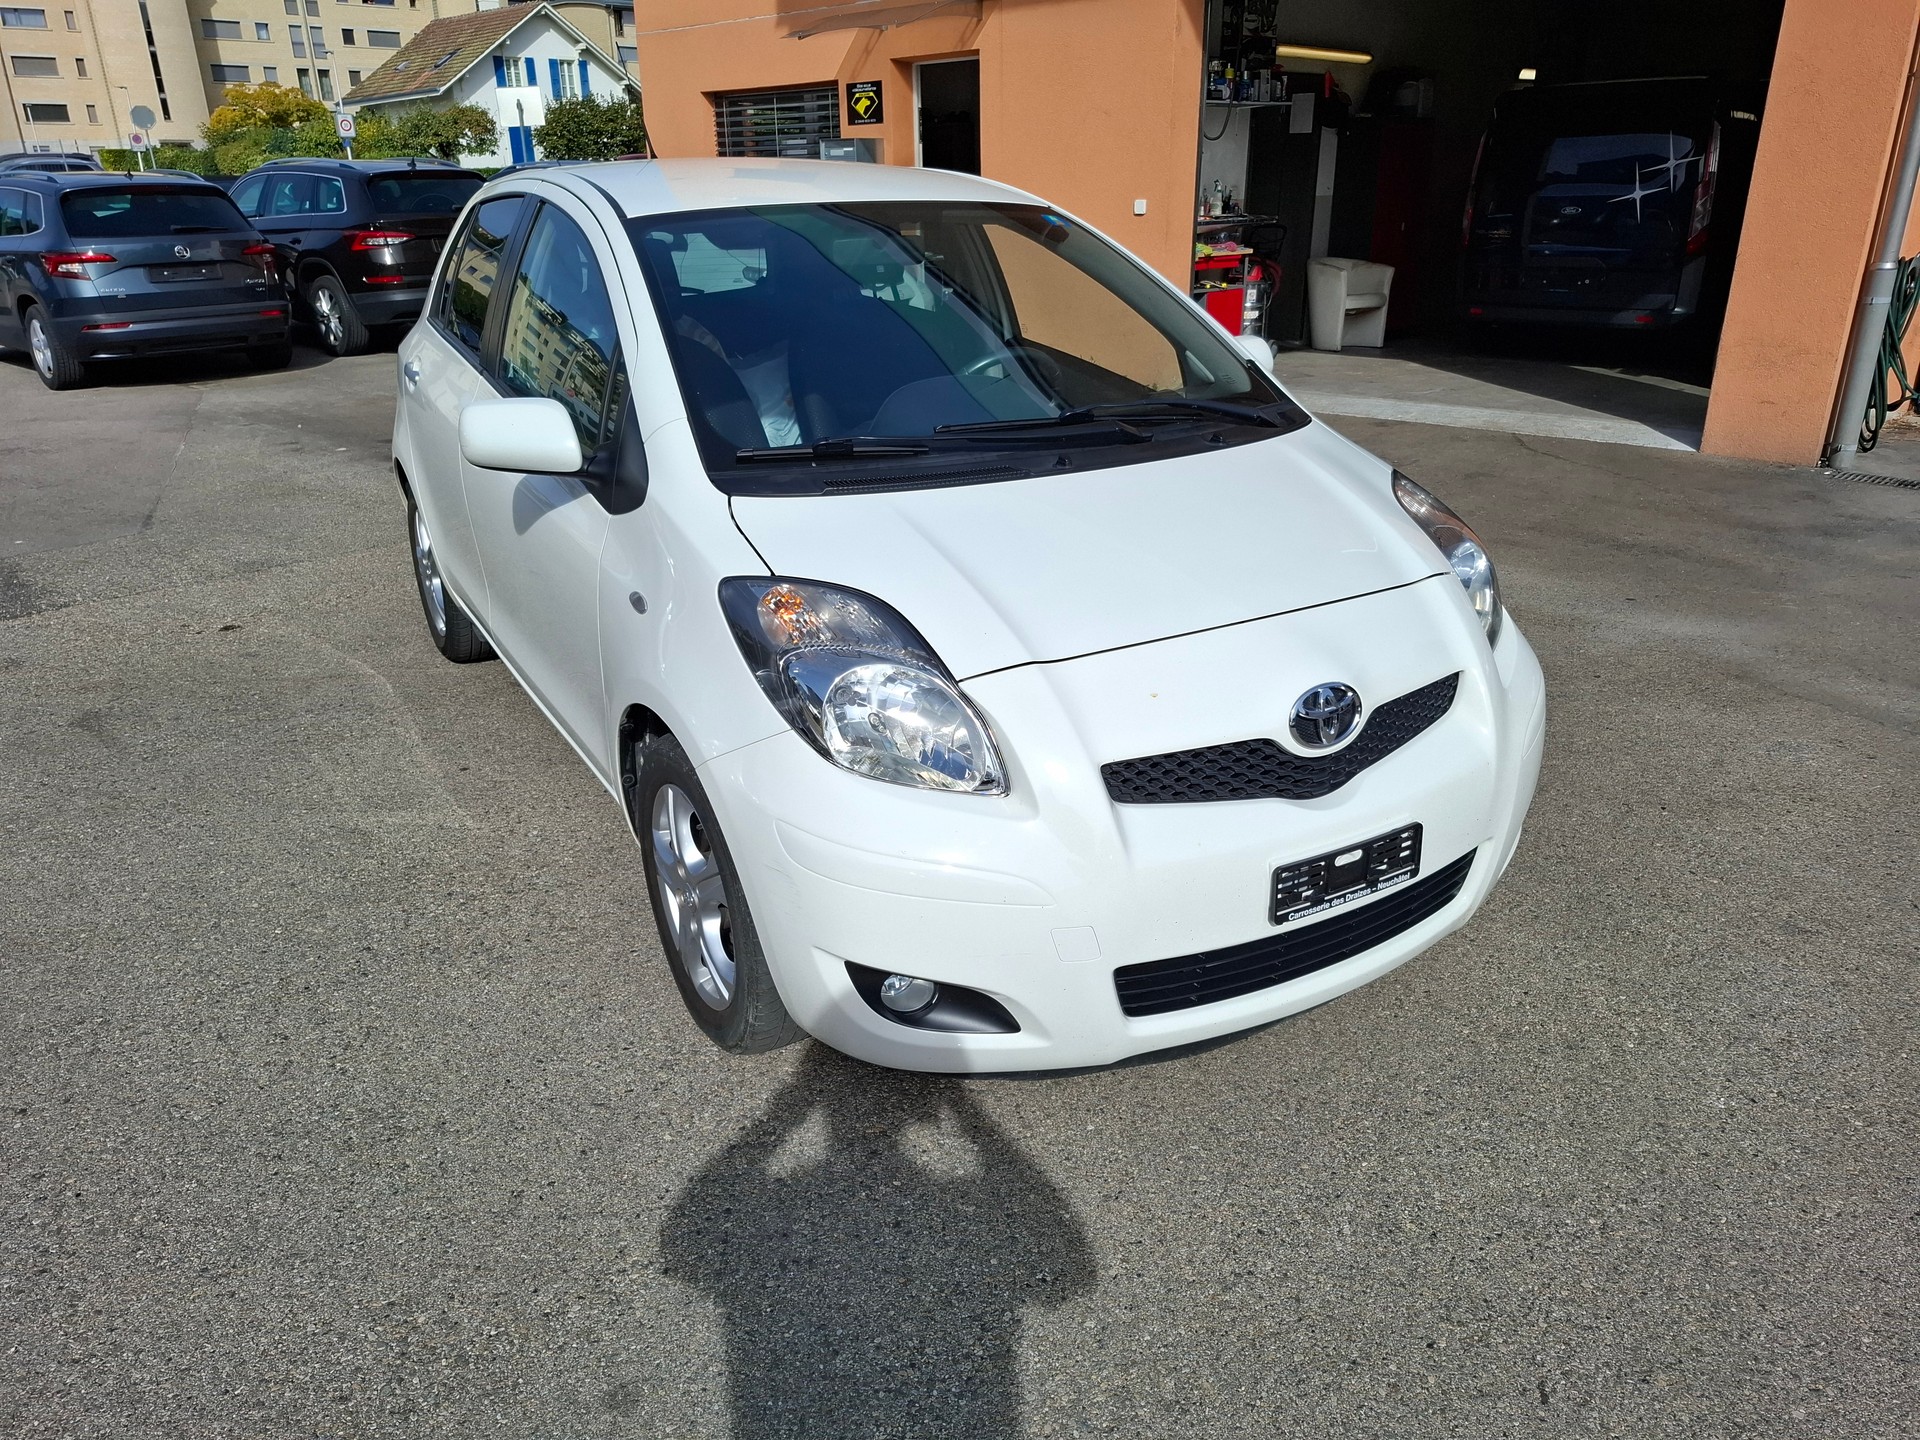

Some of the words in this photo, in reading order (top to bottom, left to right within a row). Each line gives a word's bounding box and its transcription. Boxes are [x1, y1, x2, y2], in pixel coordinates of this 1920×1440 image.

[1288, 902, 1331, 921] Carrosserie
[1331, 897, 1345, 907] des
[1345, 888, 1372, 902] Draizes
[1377, 872, 1411, 891] Neuchâtel
